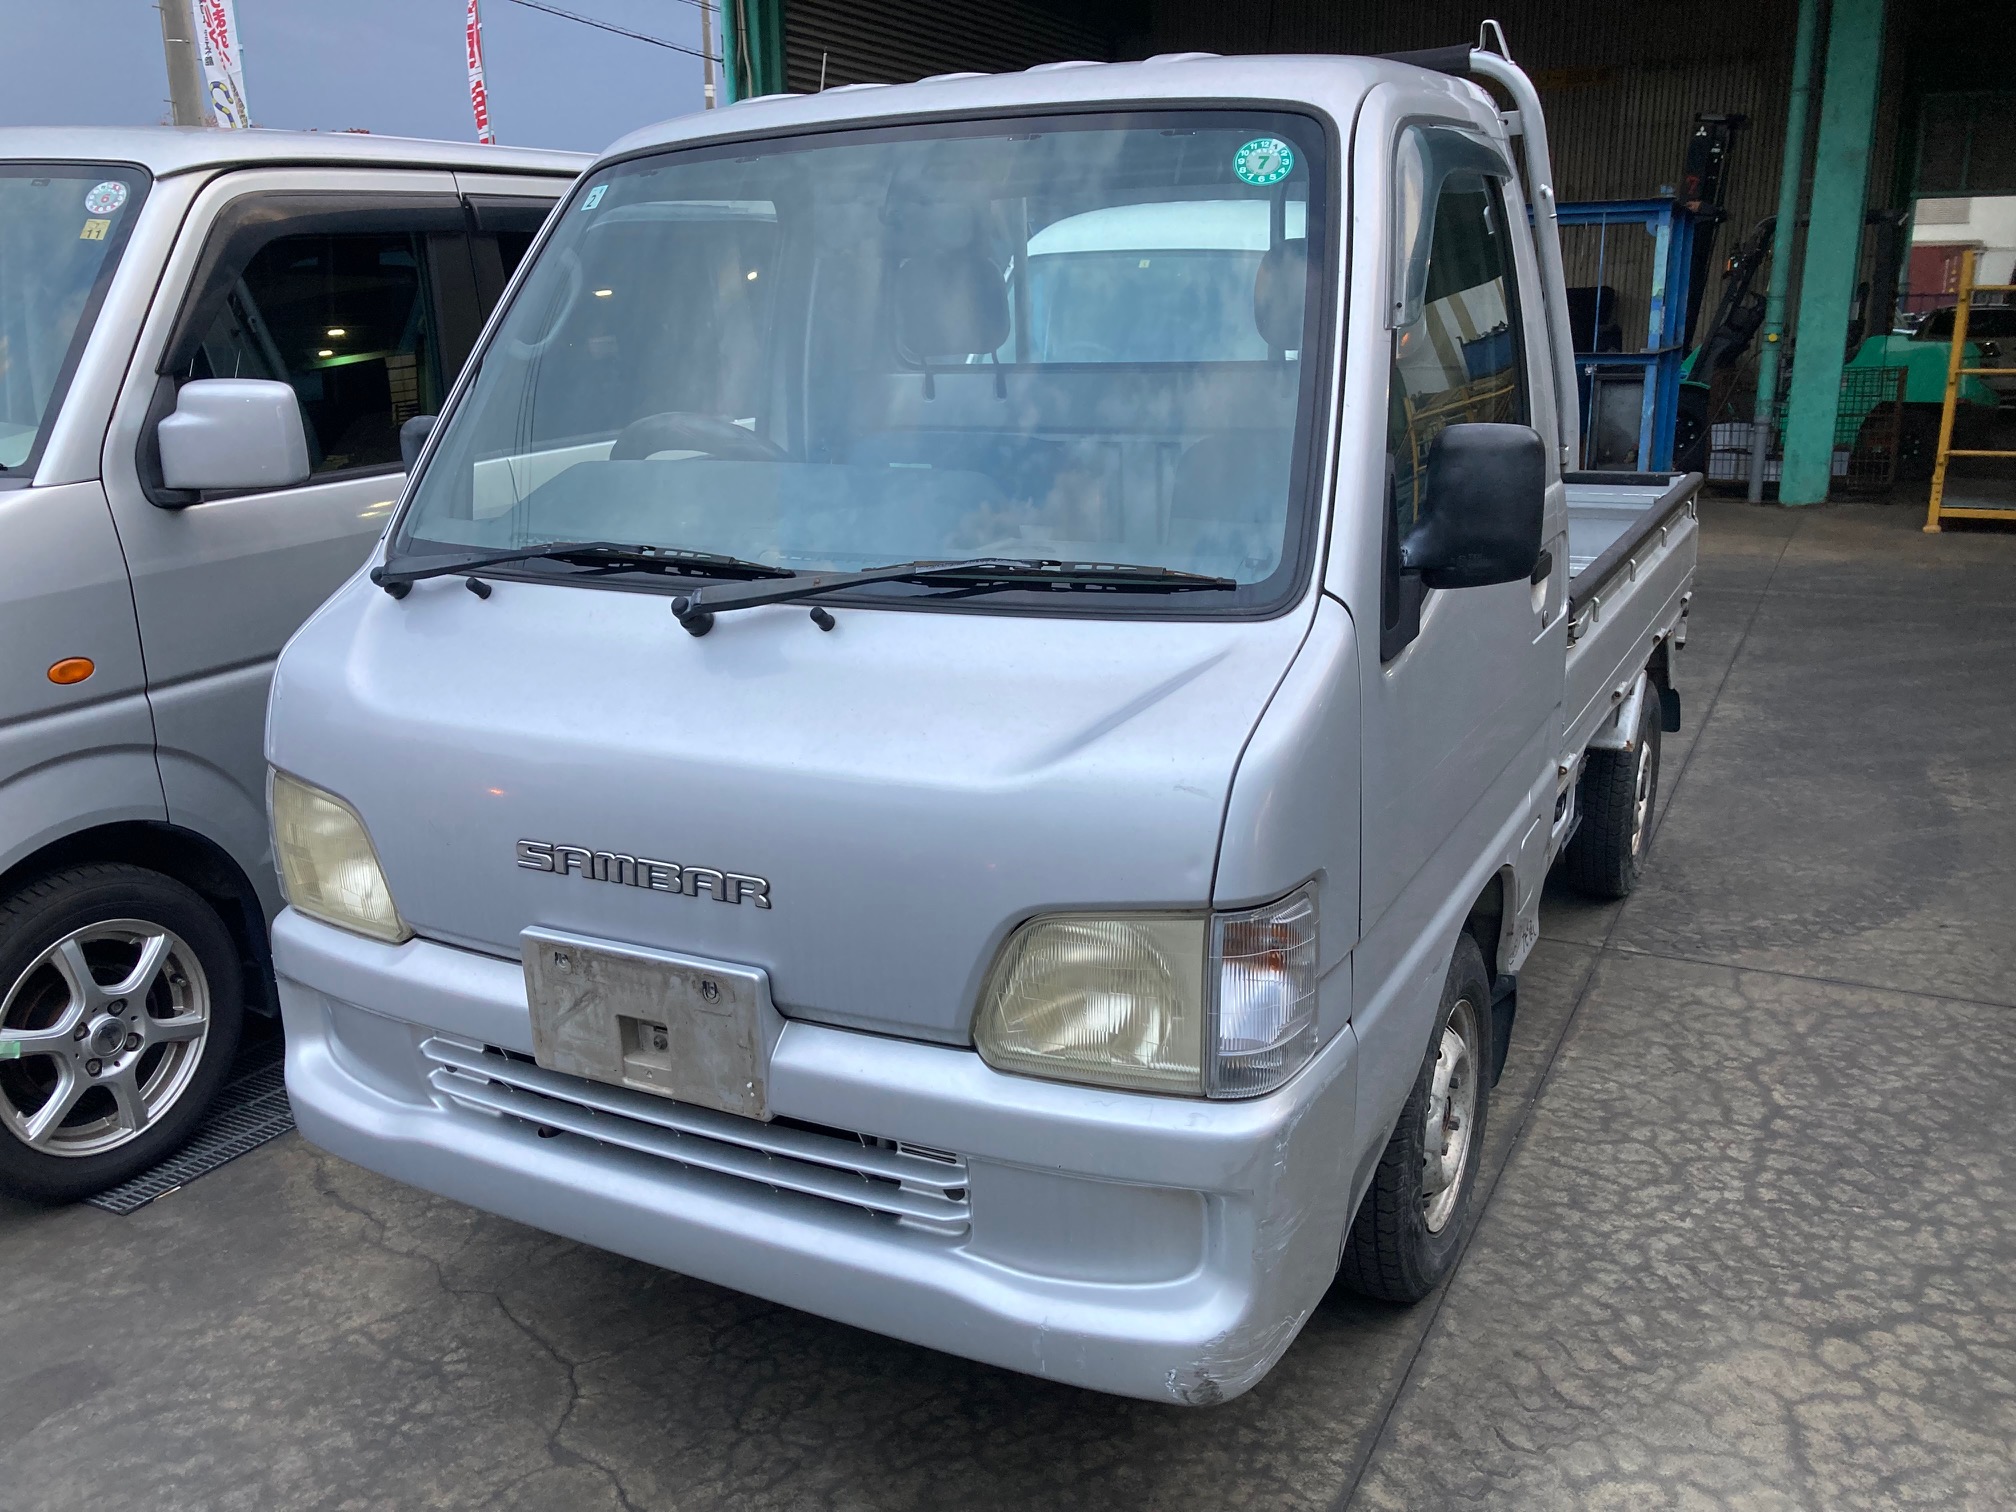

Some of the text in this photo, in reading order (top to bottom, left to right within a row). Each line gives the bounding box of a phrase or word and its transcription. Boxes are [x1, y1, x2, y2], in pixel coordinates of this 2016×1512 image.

[1258, 156, 1270, 170] 7
[100, 194, 110, 204] 6
[586, 194, 596, 208] 2
[86, 229, 102, 239] 11
[516, 839, 772, 909] SAMBAR
